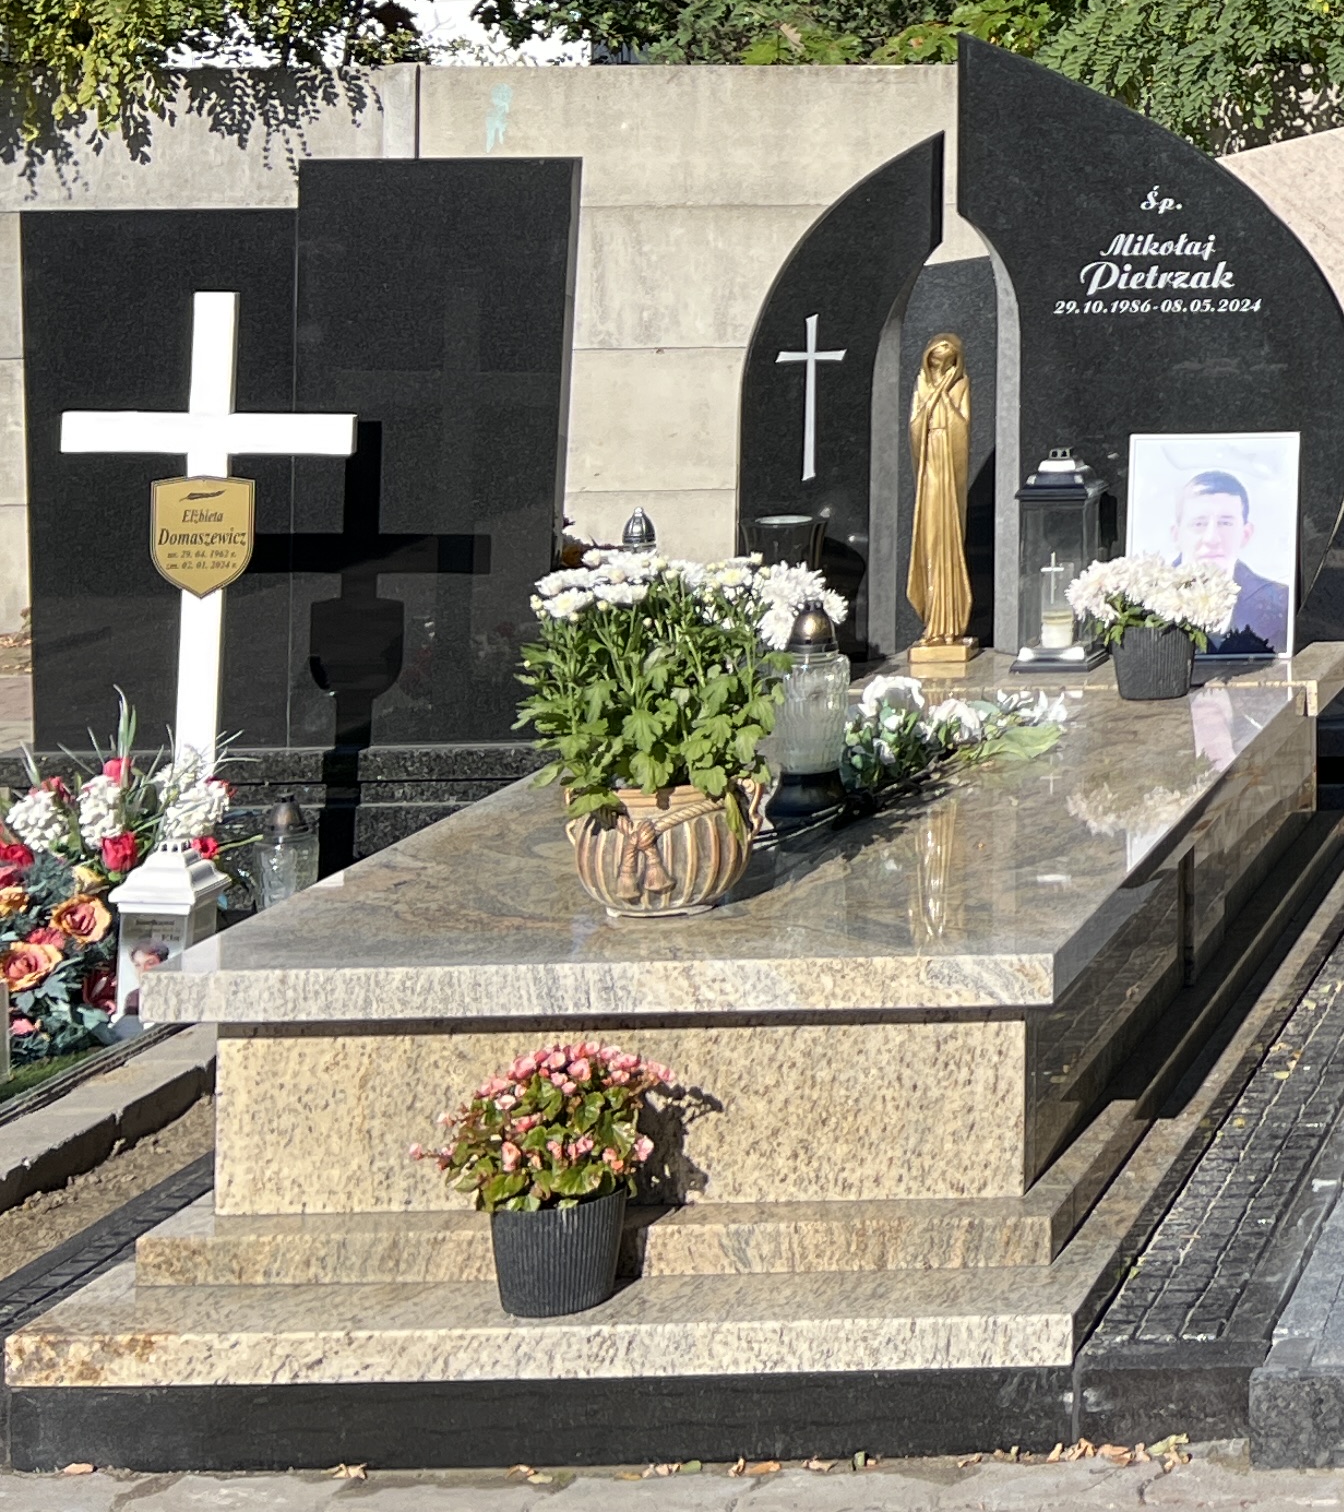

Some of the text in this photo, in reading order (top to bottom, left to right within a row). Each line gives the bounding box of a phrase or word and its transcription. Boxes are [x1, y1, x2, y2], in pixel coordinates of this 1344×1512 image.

[1140, 185, 1183, 214] Śp.
[1100, 233, 1216, 261] Mikołaj
[1079, 261, 1236, 296] Pietrzak
[181, 508, 224, 524] Elżbieta
[157, 527, 247, 547] Domaszewicz
